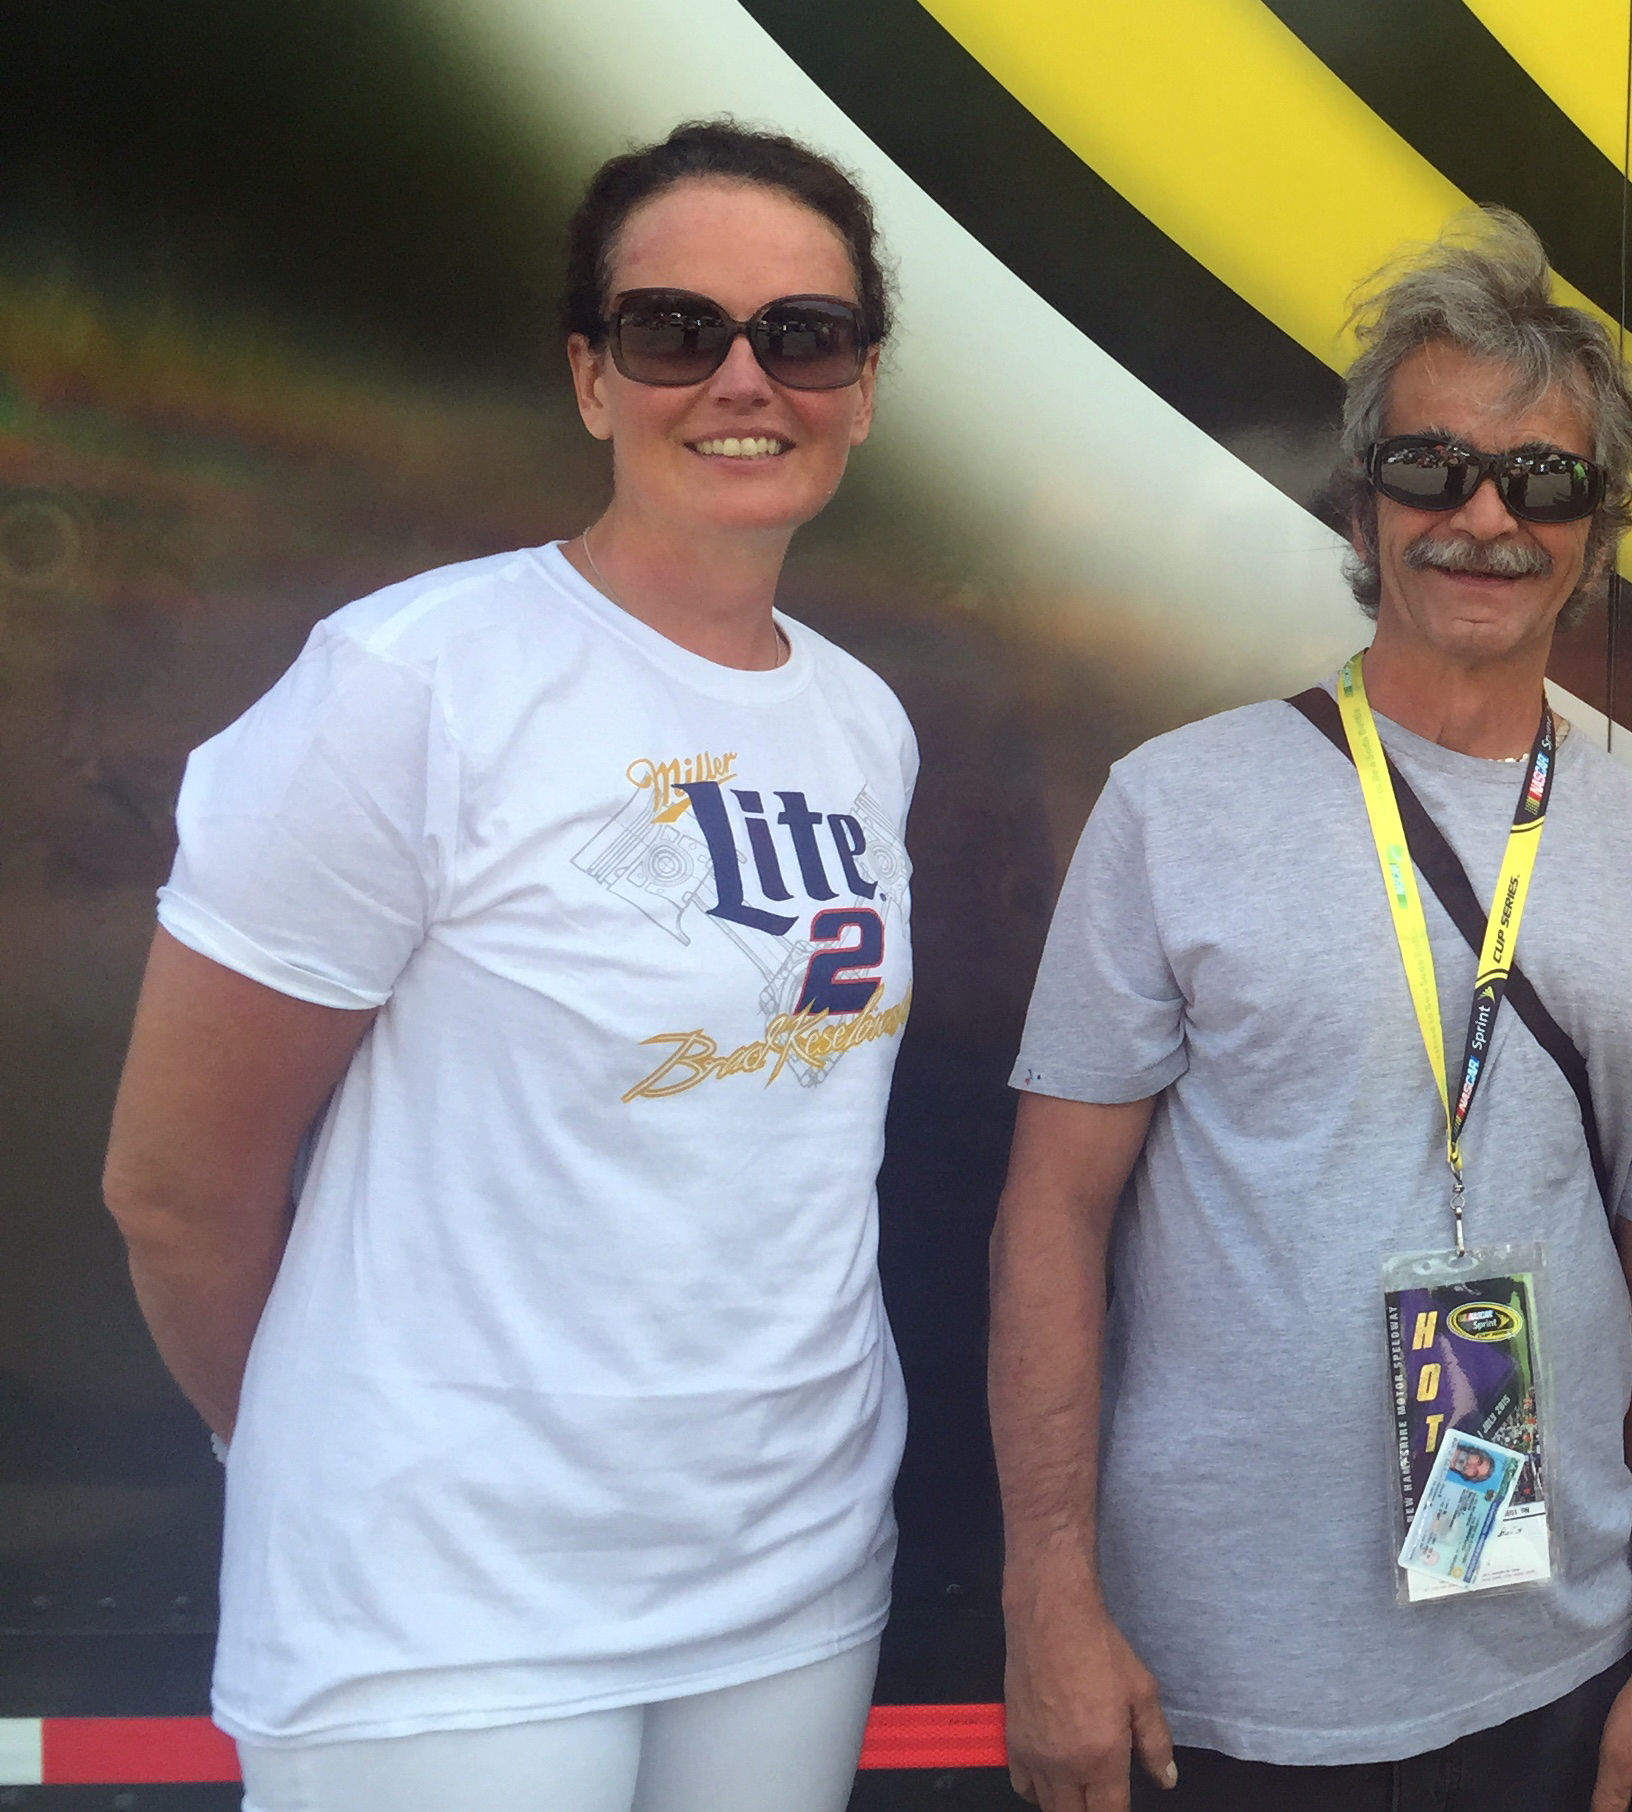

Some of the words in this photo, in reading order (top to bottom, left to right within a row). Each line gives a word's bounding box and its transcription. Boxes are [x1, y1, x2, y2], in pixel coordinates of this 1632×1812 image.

[626, 752, 738, 823] Miller
[1529, 752, 1550, 798] NASCAR
[671, 781, 879, 936] Lite
[793, 907, 885, 1017] 2
[1493, 929, 1505, 964] CUP
[1500, 875, 1519, 928] SERIES
[621, 1014, 789, 1103] Brad
[764, 978, 914, 1091] Keselow
[1457, 1057, 1480, 1113] NASCAR
[1472, 1005, 1491, 1050] Sprint
[1388, 1306, 1404, 1369] SPEEDWAY
[1472, 1319, 1497, 1331] Sprint
[1394, 1374, 1407, 1416] MOTOR
[1412, 1311, 1444, 1453] HOT
